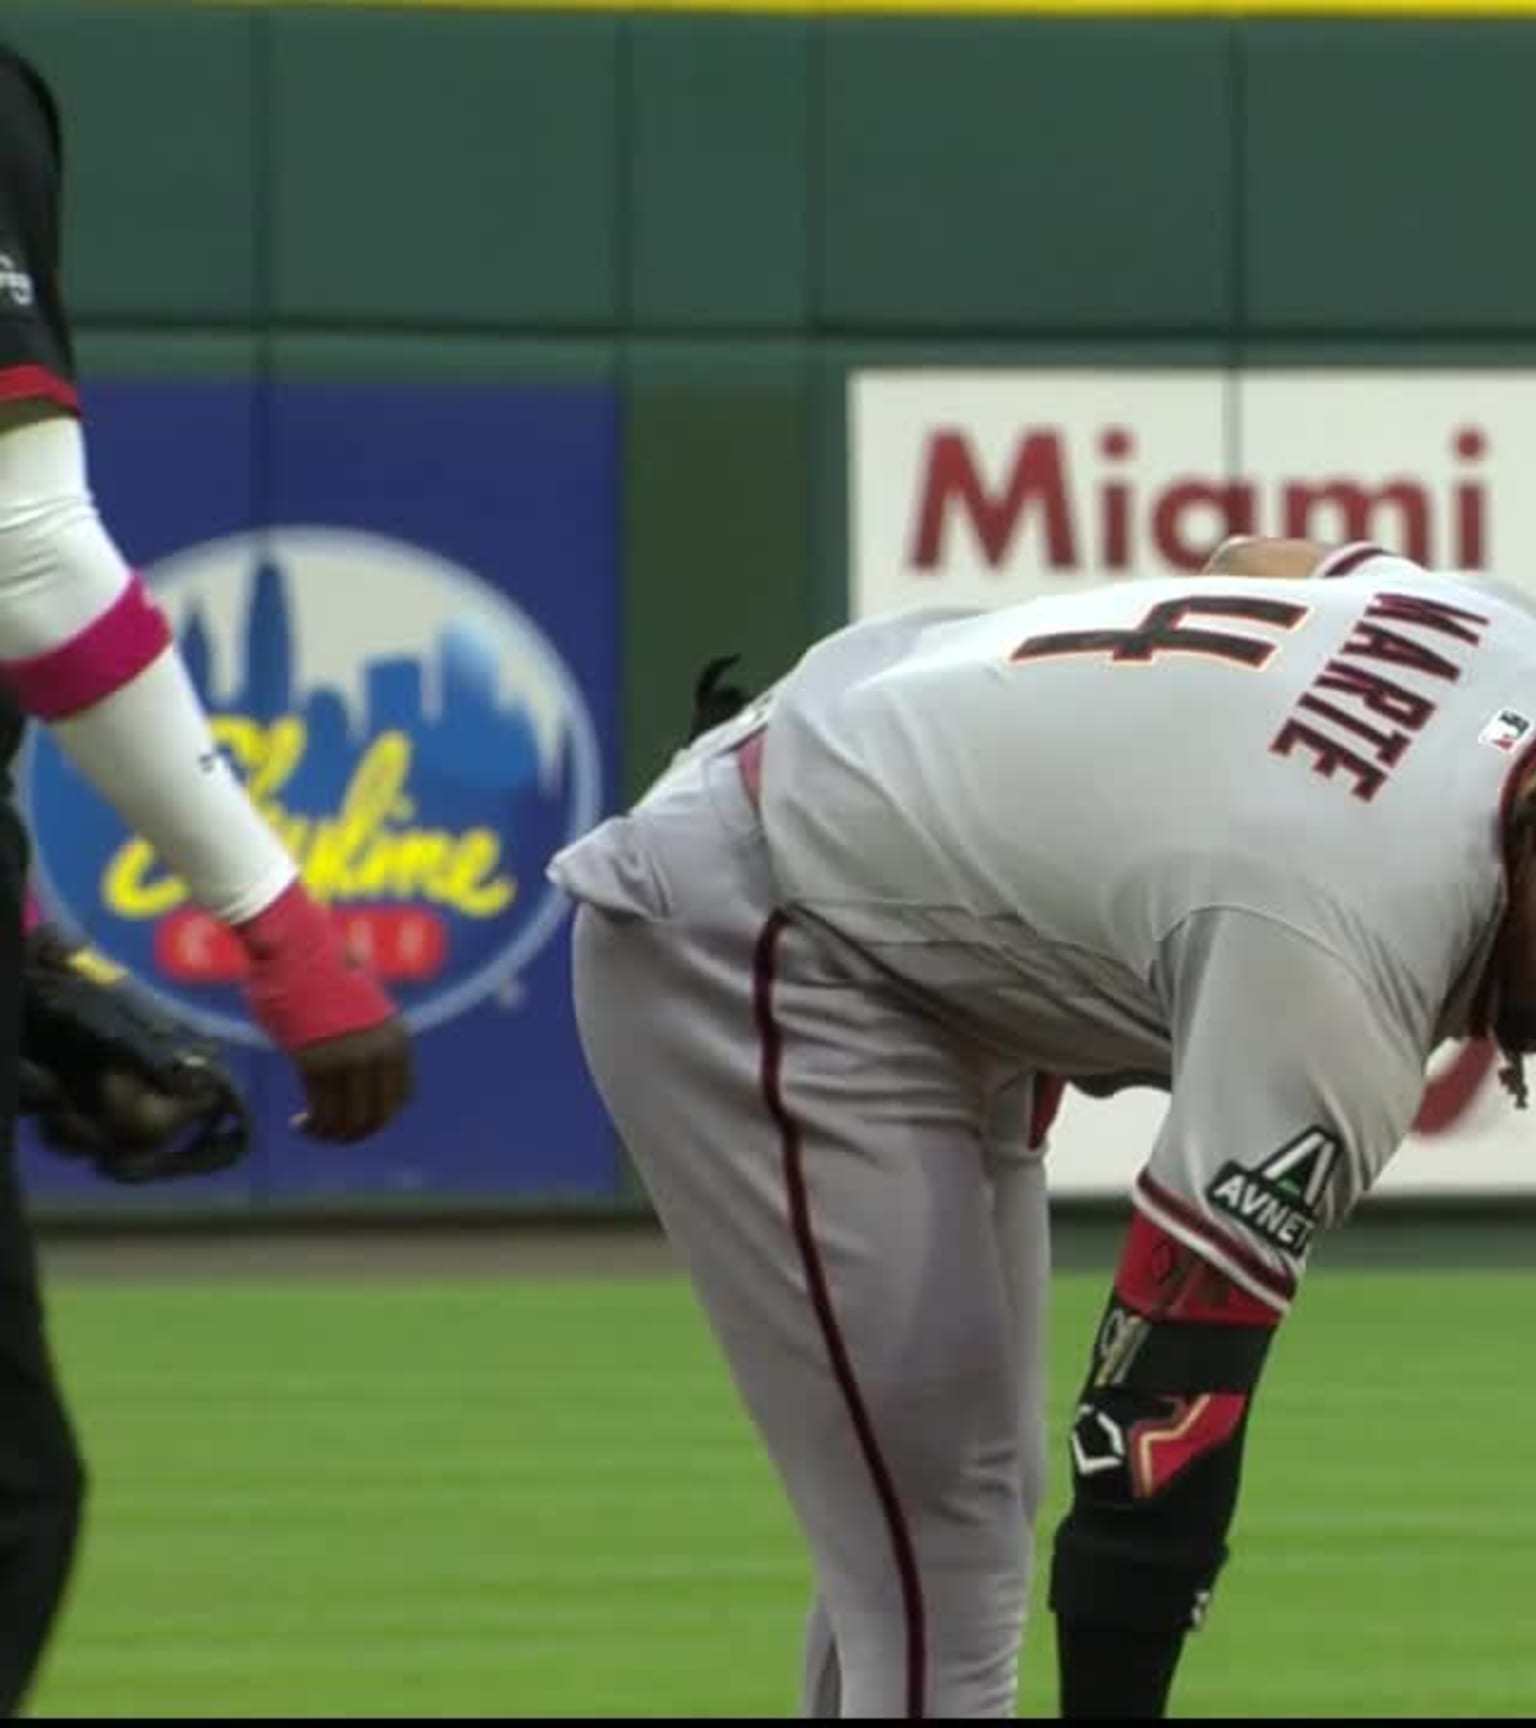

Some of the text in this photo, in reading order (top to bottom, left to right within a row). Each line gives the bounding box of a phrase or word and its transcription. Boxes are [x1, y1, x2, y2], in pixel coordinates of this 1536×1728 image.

[908, 426, 1491, 572] Miami
[1009, 594, 1309, 671] 4
[1268, 590, 1492, 805] MARTE
[1212, 1174, 1316, 1250] AVNET
